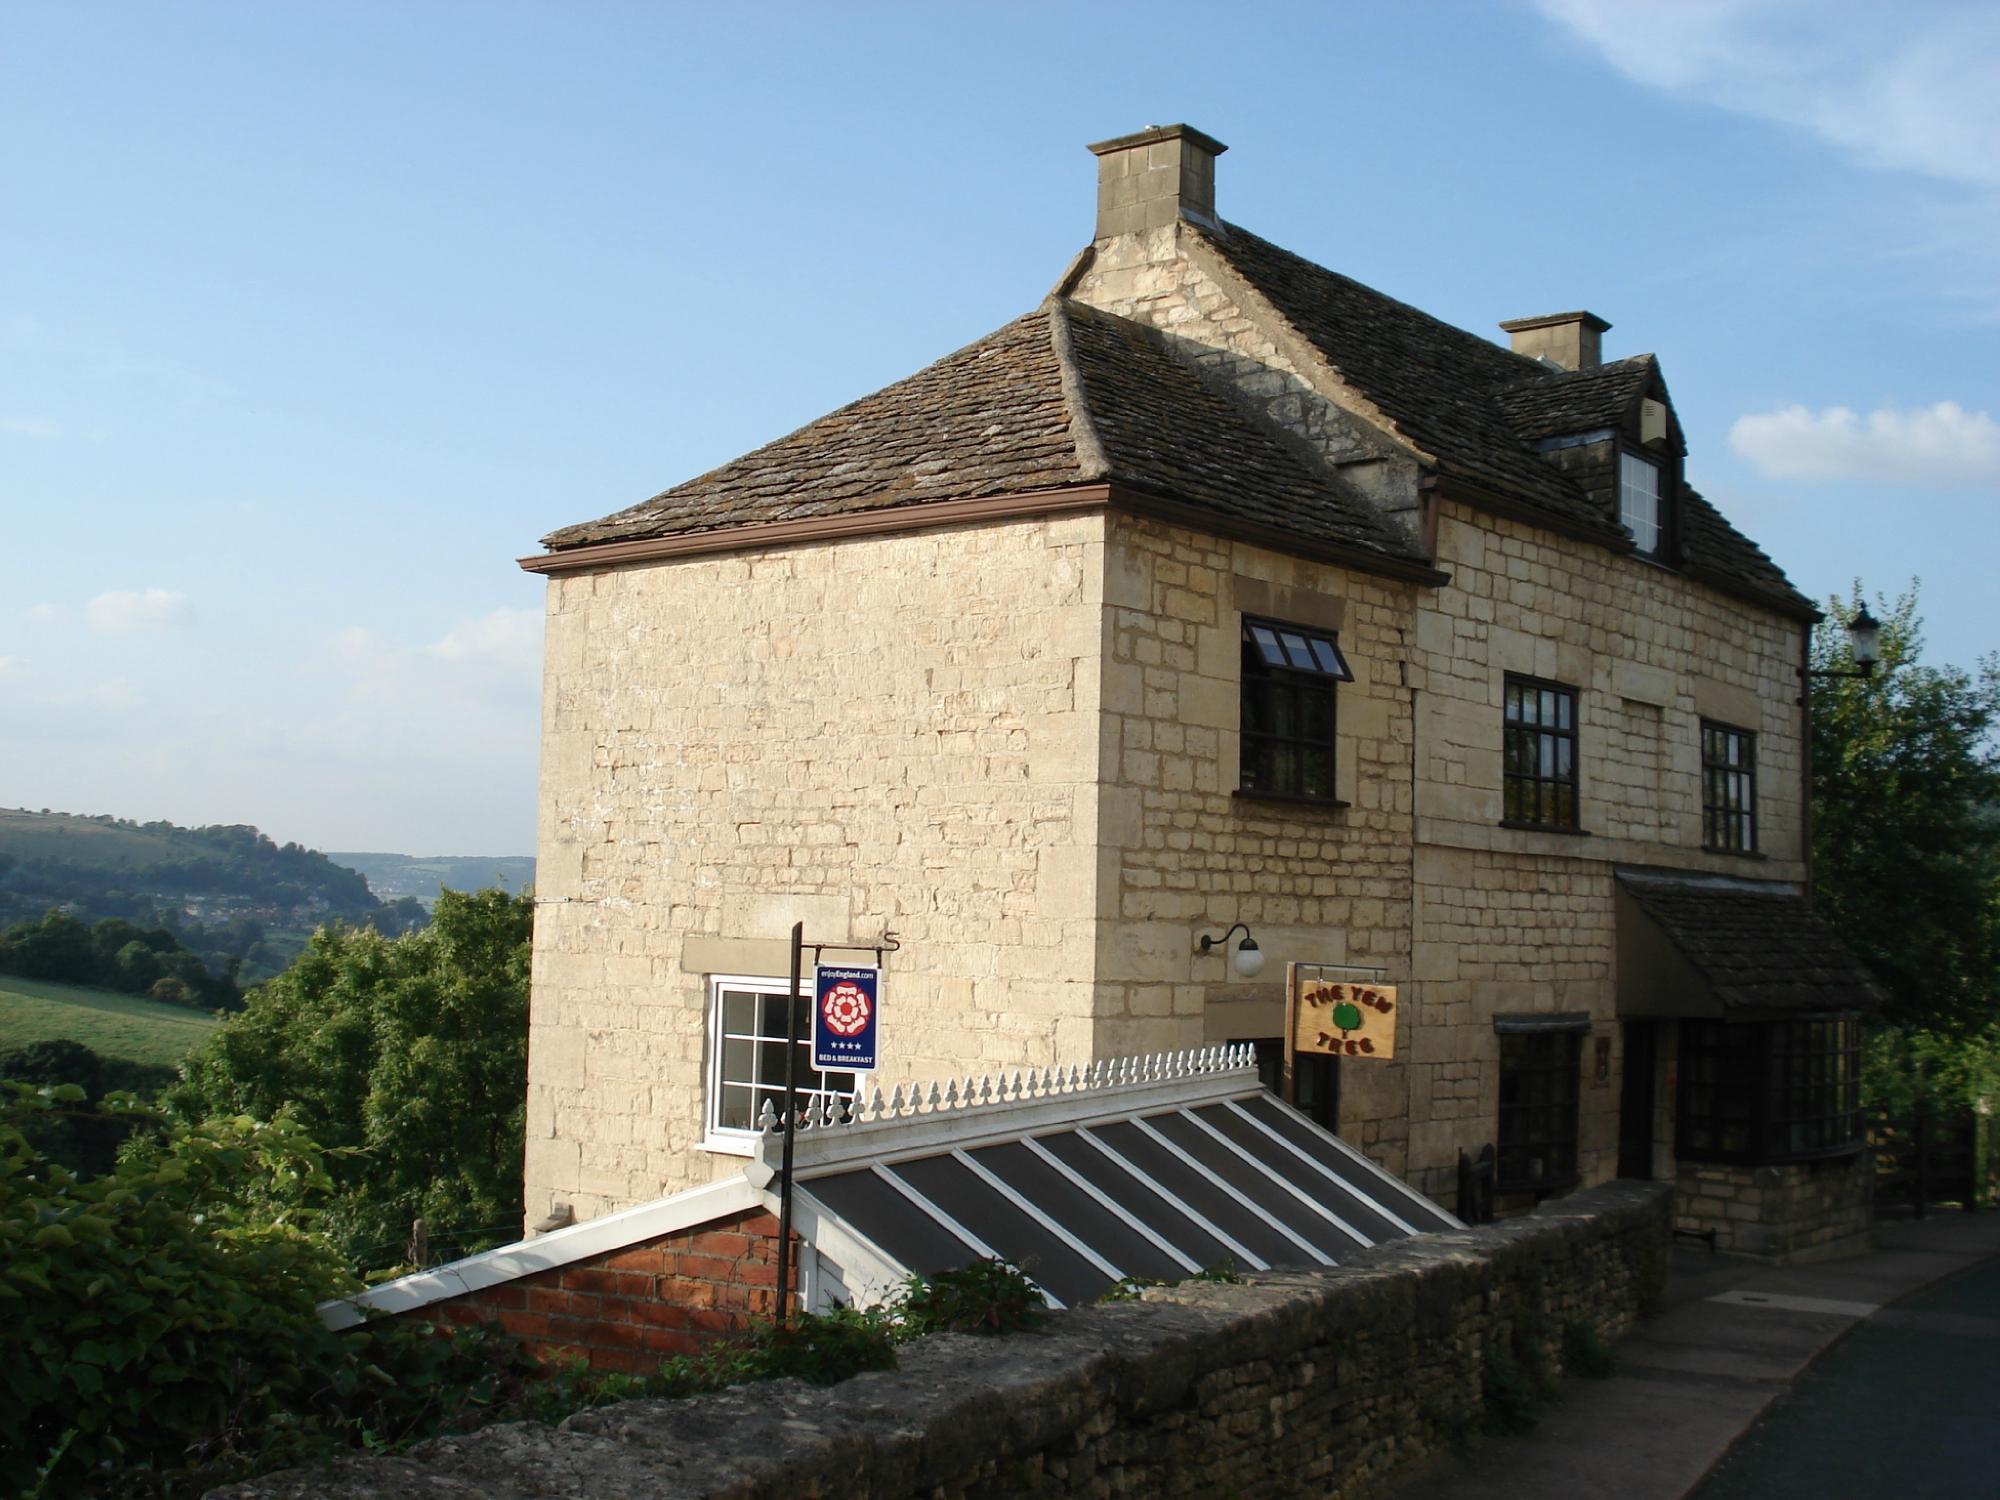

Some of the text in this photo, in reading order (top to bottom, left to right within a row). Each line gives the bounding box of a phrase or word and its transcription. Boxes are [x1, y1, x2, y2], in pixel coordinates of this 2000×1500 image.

[821, 970, 874, 979] enjoyEngland.com
[1304, 985, 1393, 1014] THE YEW
[1317, 1032, 1375, 1055] TREE
[838, 1055, 873, 1063] BREAKFAST
